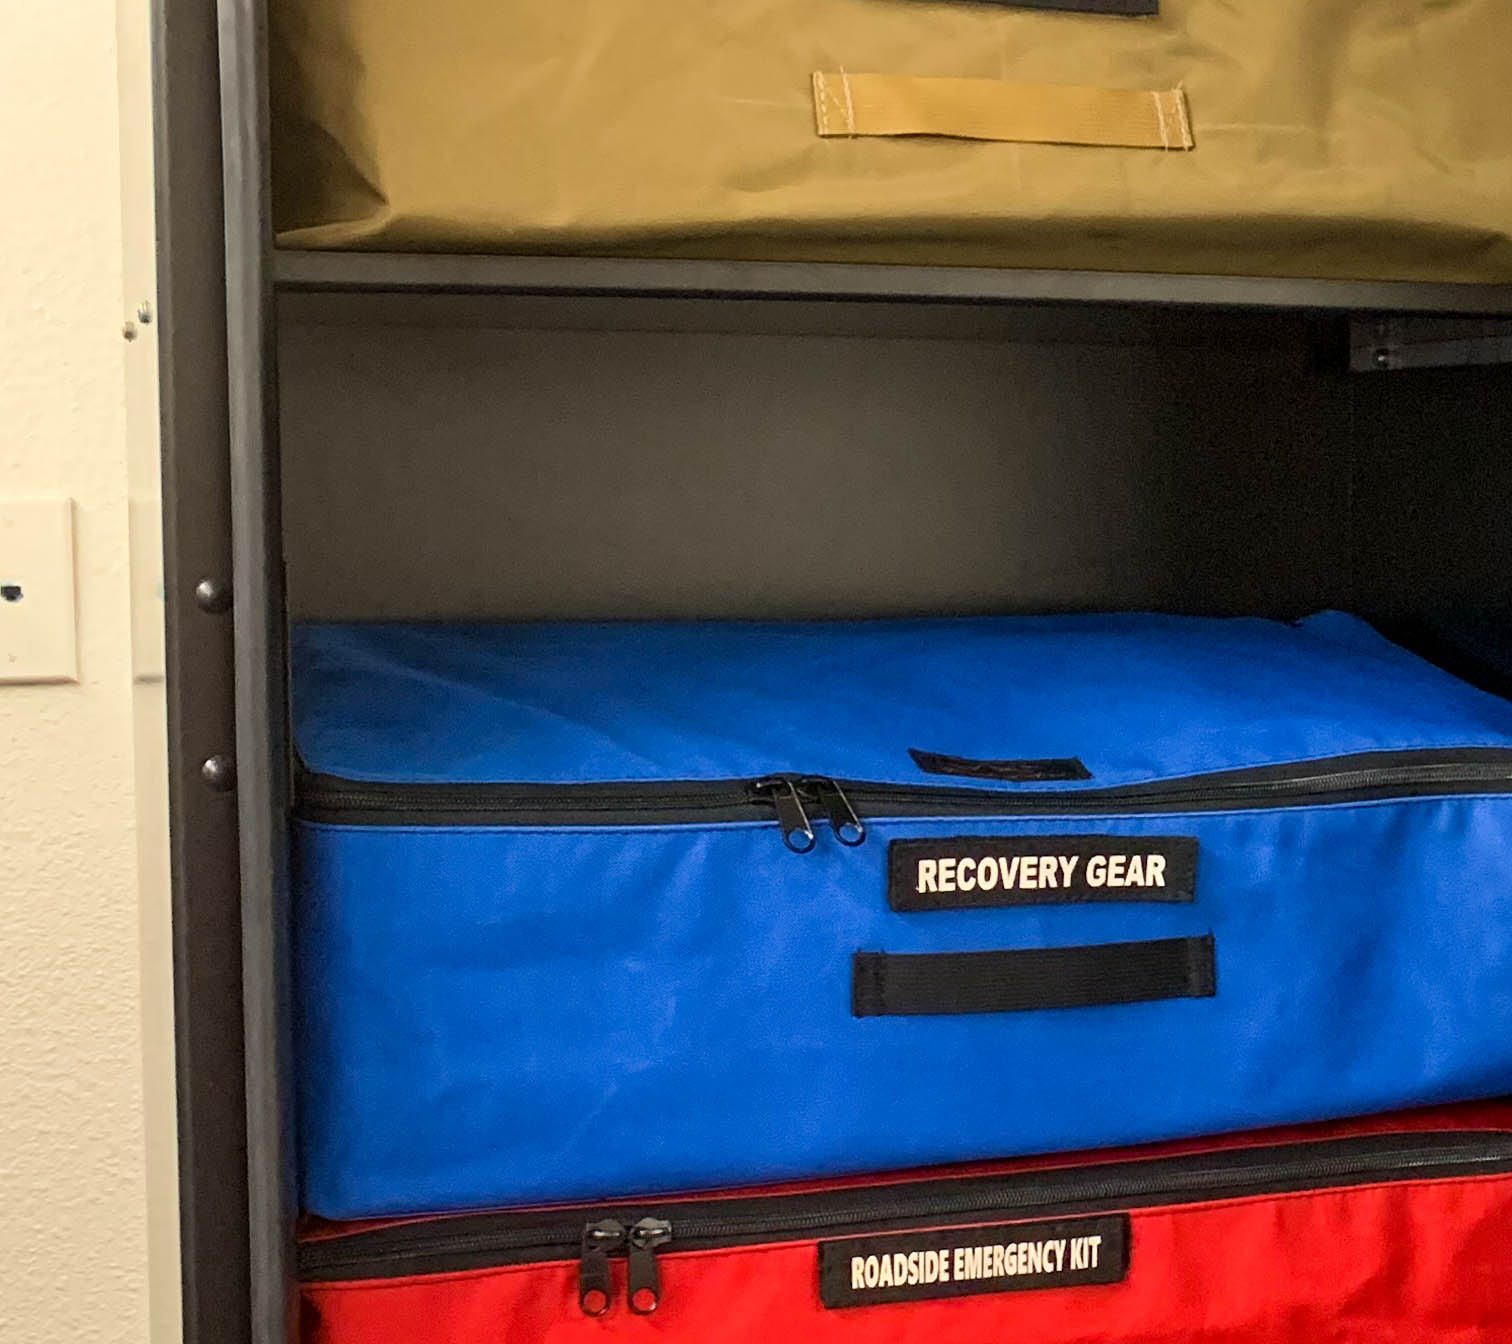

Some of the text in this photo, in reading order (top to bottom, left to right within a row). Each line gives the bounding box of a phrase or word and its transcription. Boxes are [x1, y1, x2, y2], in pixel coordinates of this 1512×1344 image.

[916, 854, 1167, 894] RECOVERY GEAR
[851, 1234, 1102, 1290] ROADSIDE EMERGENCY KIT
